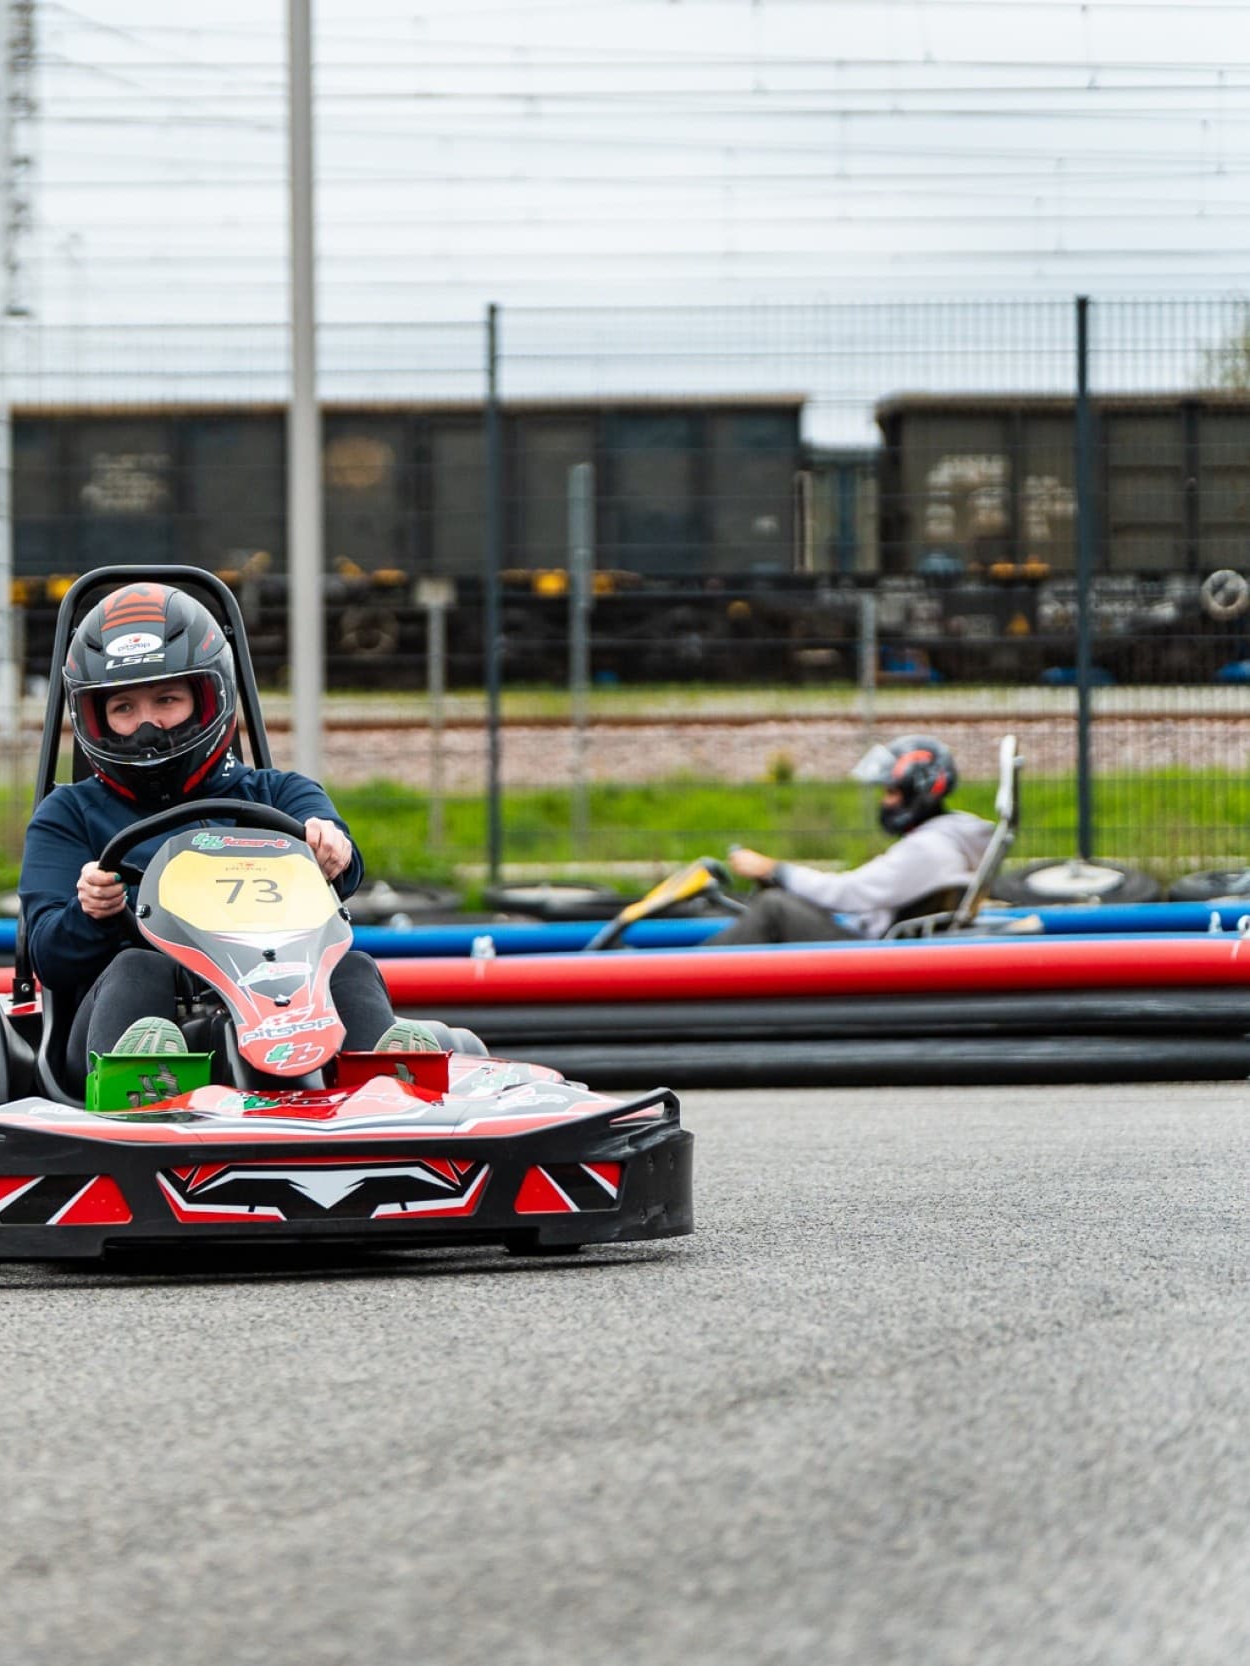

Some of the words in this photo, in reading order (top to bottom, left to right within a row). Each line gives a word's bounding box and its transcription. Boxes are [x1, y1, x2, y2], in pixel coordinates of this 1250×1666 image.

[105, 652, 166, 670] LS2
[215, 879, 283, 904] 73
[241, 1017, 335, 1045] pitstop
